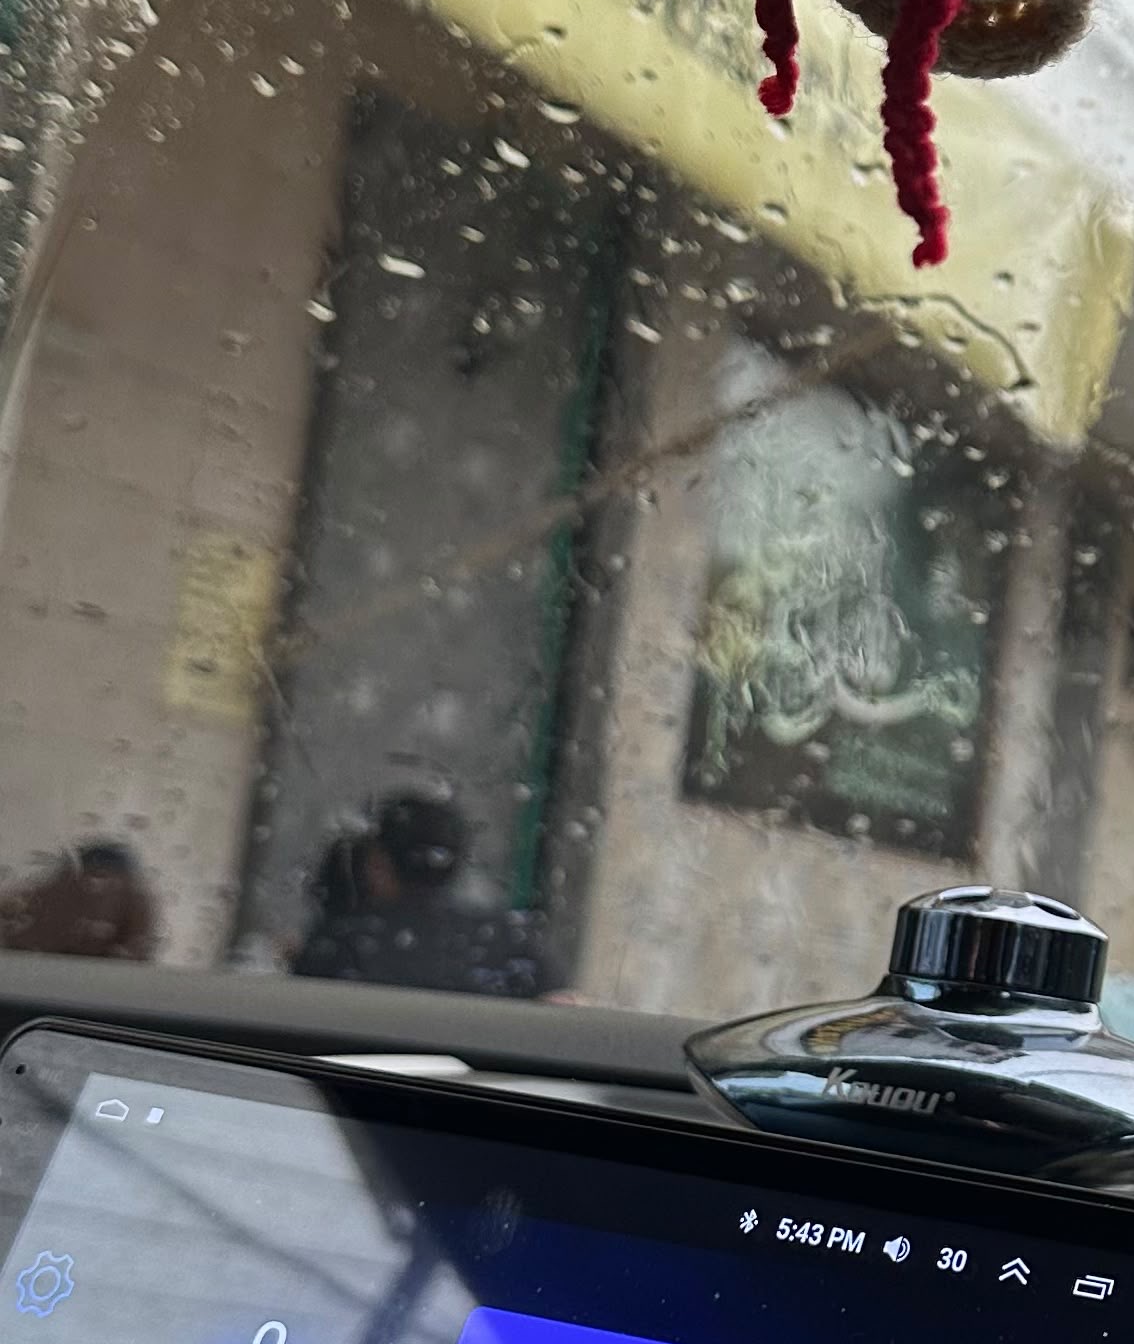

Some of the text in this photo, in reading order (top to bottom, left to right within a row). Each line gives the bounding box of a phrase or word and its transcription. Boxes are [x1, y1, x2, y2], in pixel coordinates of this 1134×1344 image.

[776, 1217, 968, 1272] 5:43 PM 30
